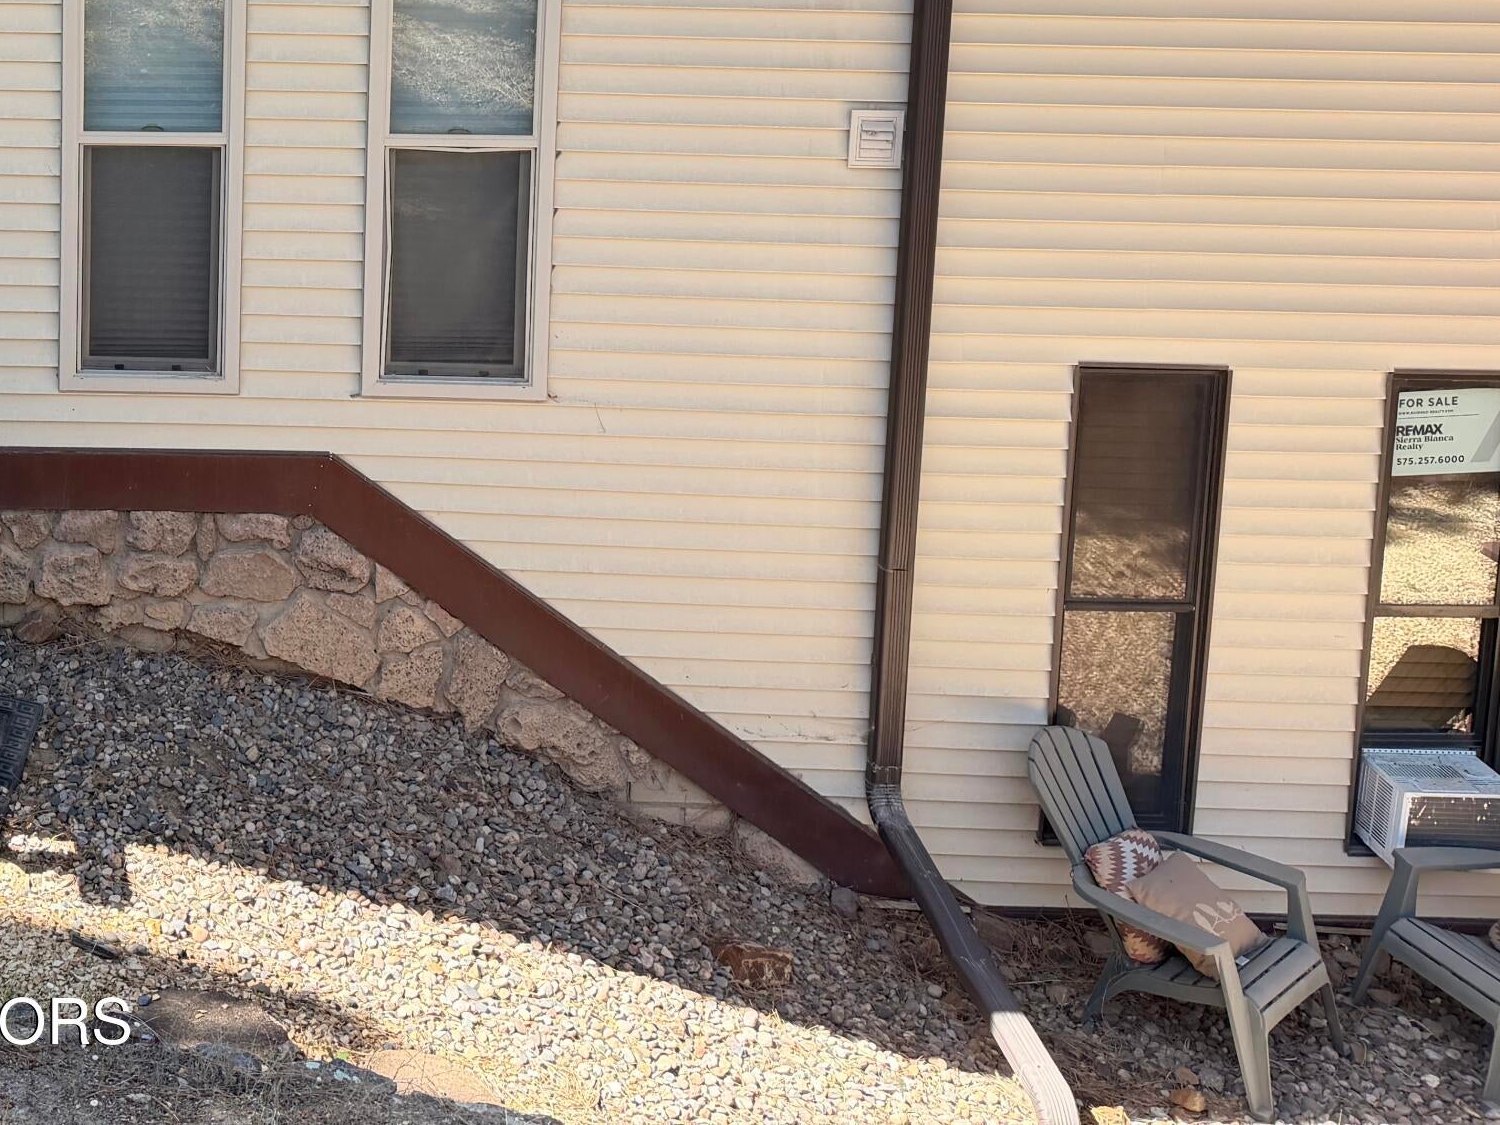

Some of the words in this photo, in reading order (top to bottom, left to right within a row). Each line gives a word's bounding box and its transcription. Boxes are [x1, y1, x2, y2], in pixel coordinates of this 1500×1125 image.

[1398, 398, 1424, 408] FOR
[1428, 396, 1459, 406] SALE
[1396, 436, 1422, 444] Sierra
[1396, 443, 1424, 451] Realty
[1396, 455, 1465, 466] 575.257.6000
